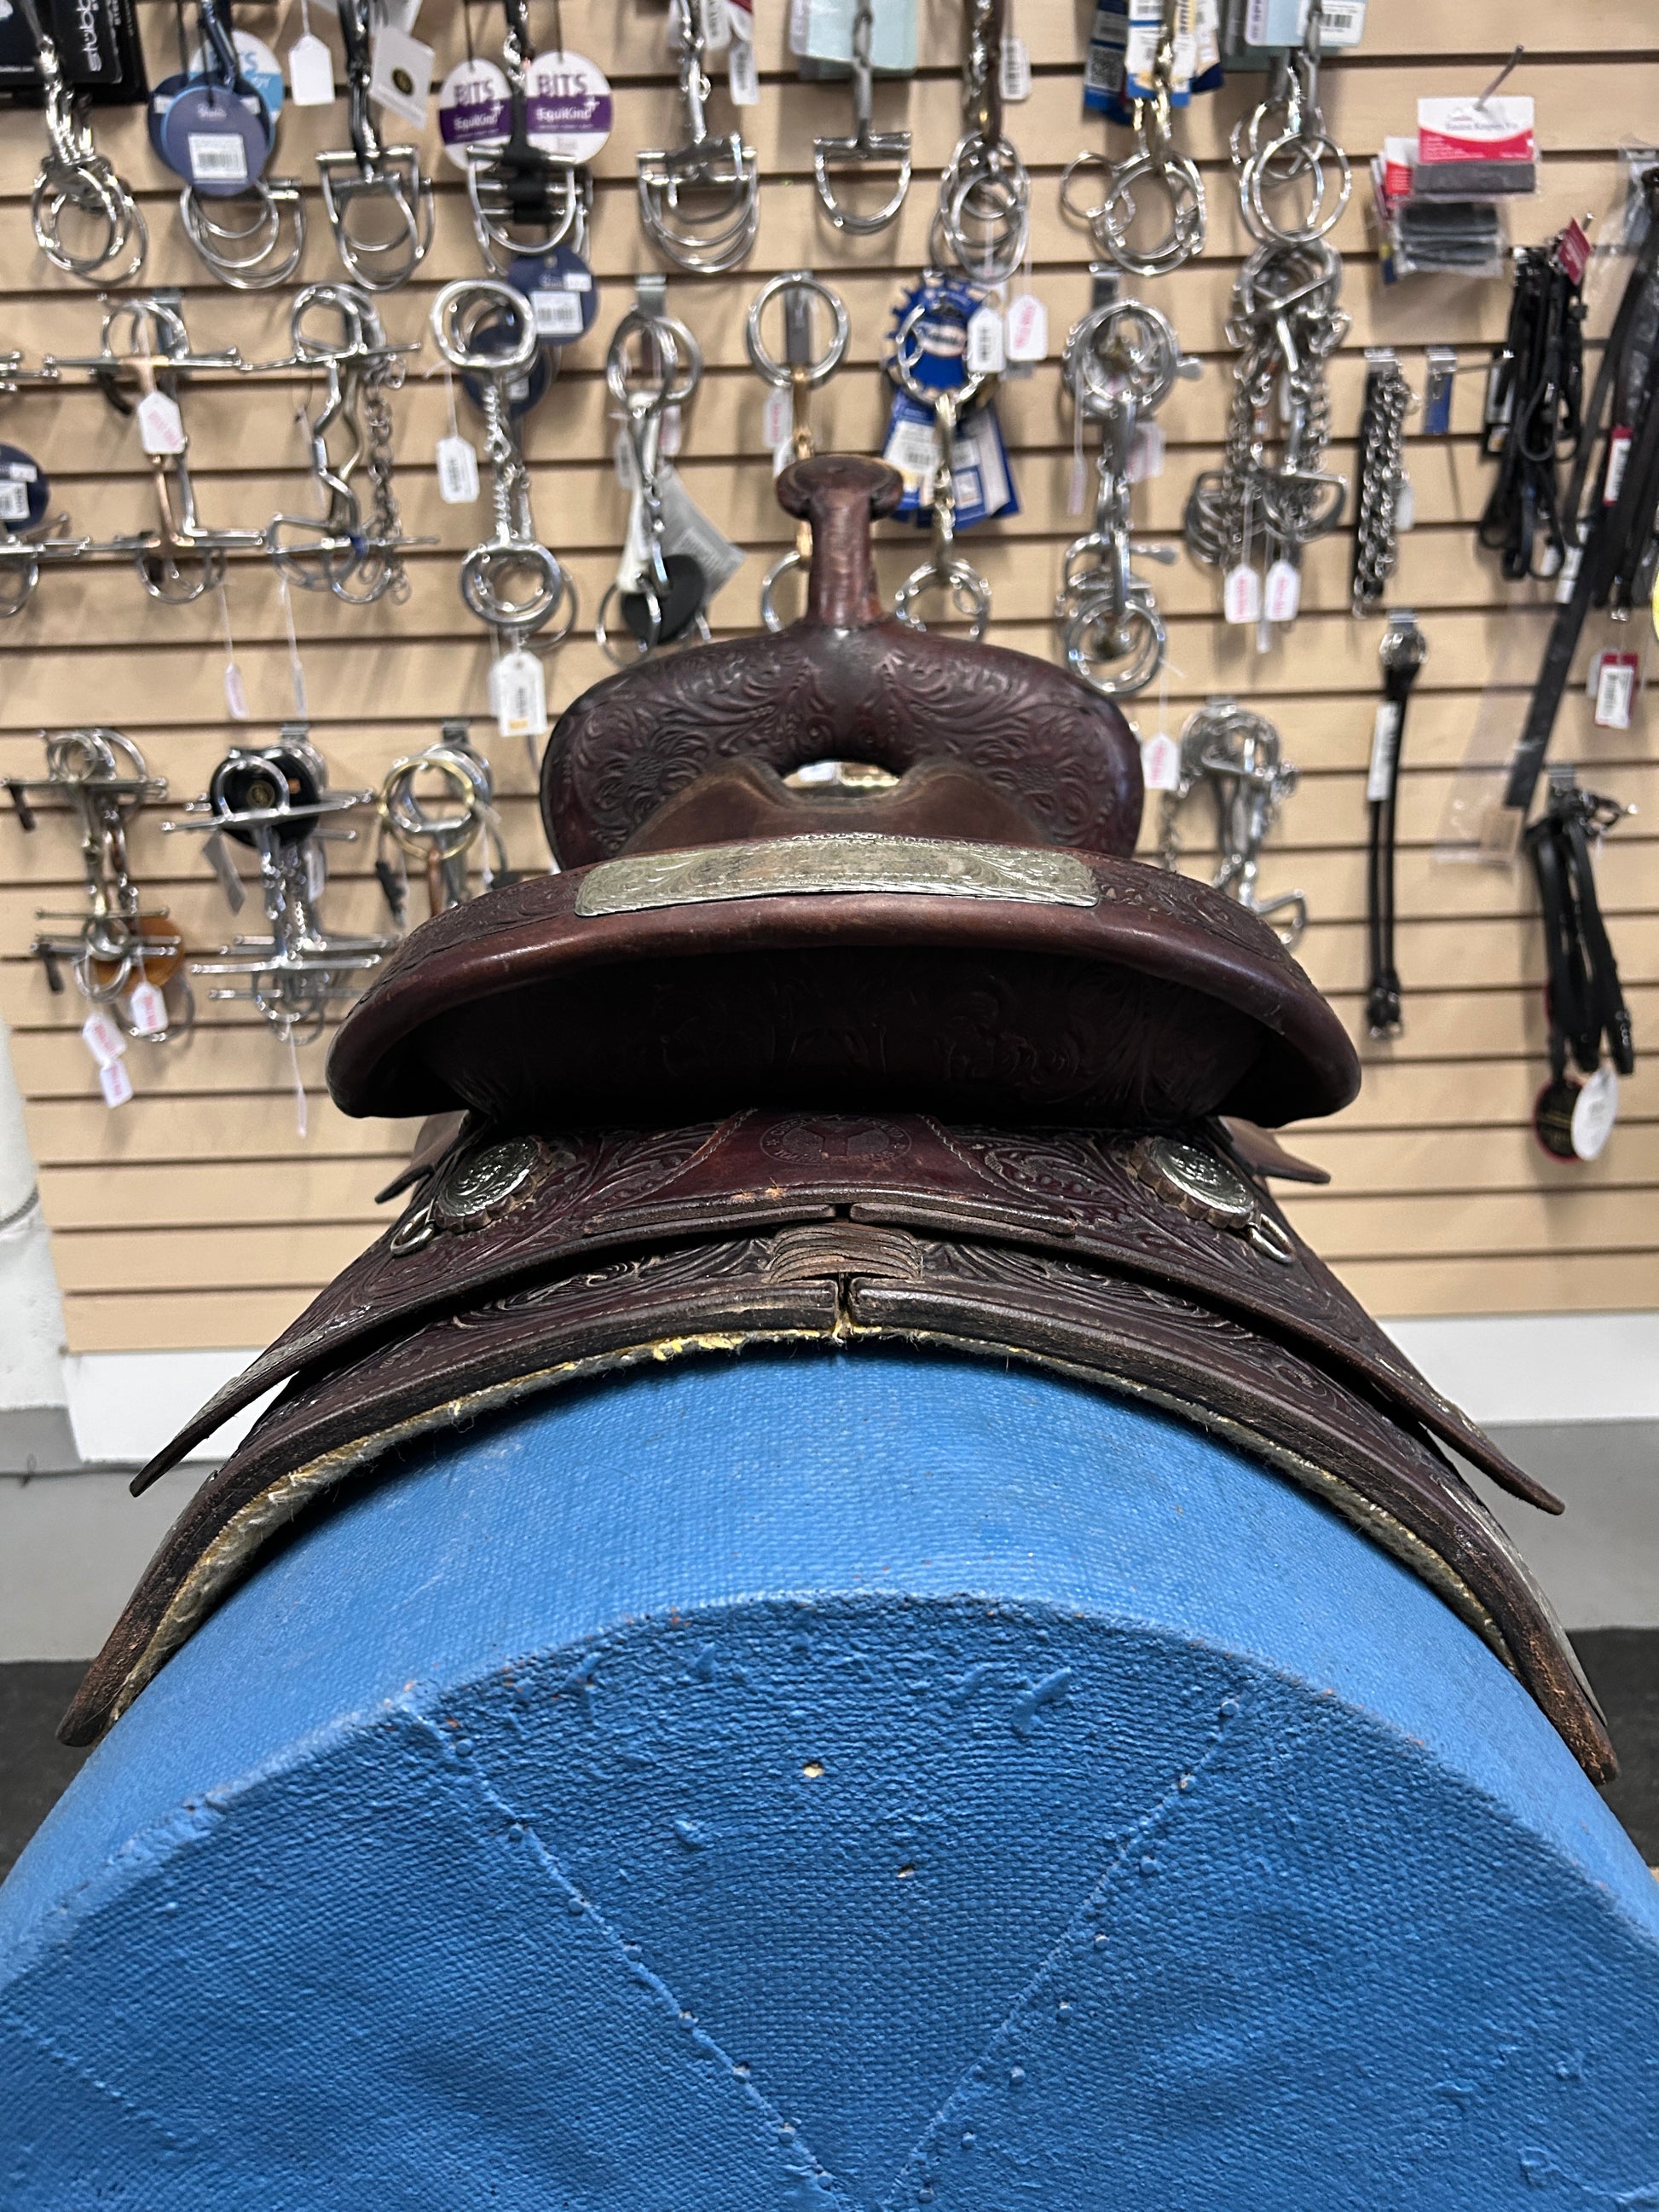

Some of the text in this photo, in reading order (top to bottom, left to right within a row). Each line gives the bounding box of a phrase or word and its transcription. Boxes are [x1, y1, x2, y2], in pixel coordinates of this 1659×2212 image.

[454, 79, 495, 106] BITS
[538, 73, 587, 97] BITS
[535, 104, 591, 124] EquiKind
